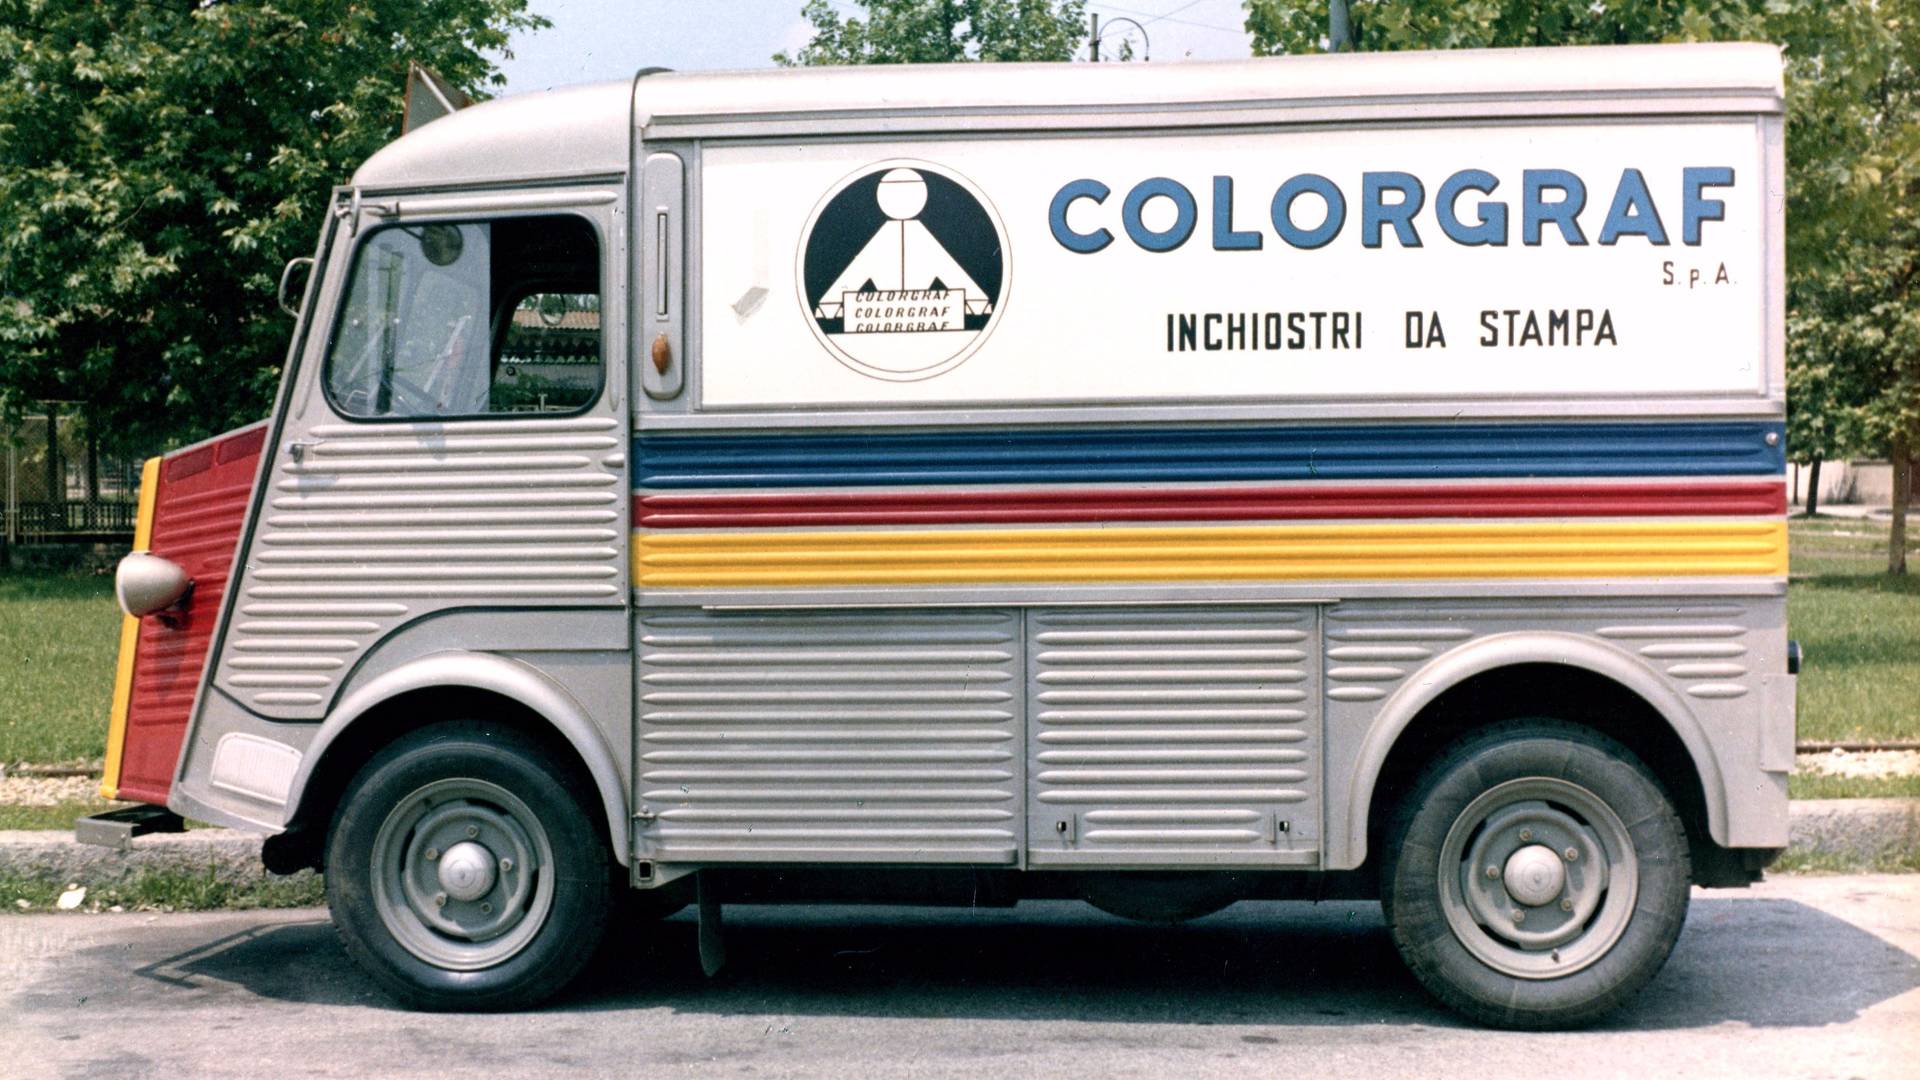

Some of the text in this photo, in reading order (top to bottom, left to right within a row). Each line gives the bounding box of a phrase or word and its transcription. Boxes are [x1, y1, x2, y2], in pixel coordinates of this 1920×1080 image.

[1048, 167, 1736, 254] COLORGRAF
[855, 290, 950, 302] COLORGRAF
[855, 306, 950, 318] COLORGRAF
[856, 321, 950, 333] COLORGRAF
[1166, 307, 1618, 352] INCHIOSTRI DA STAMPA
